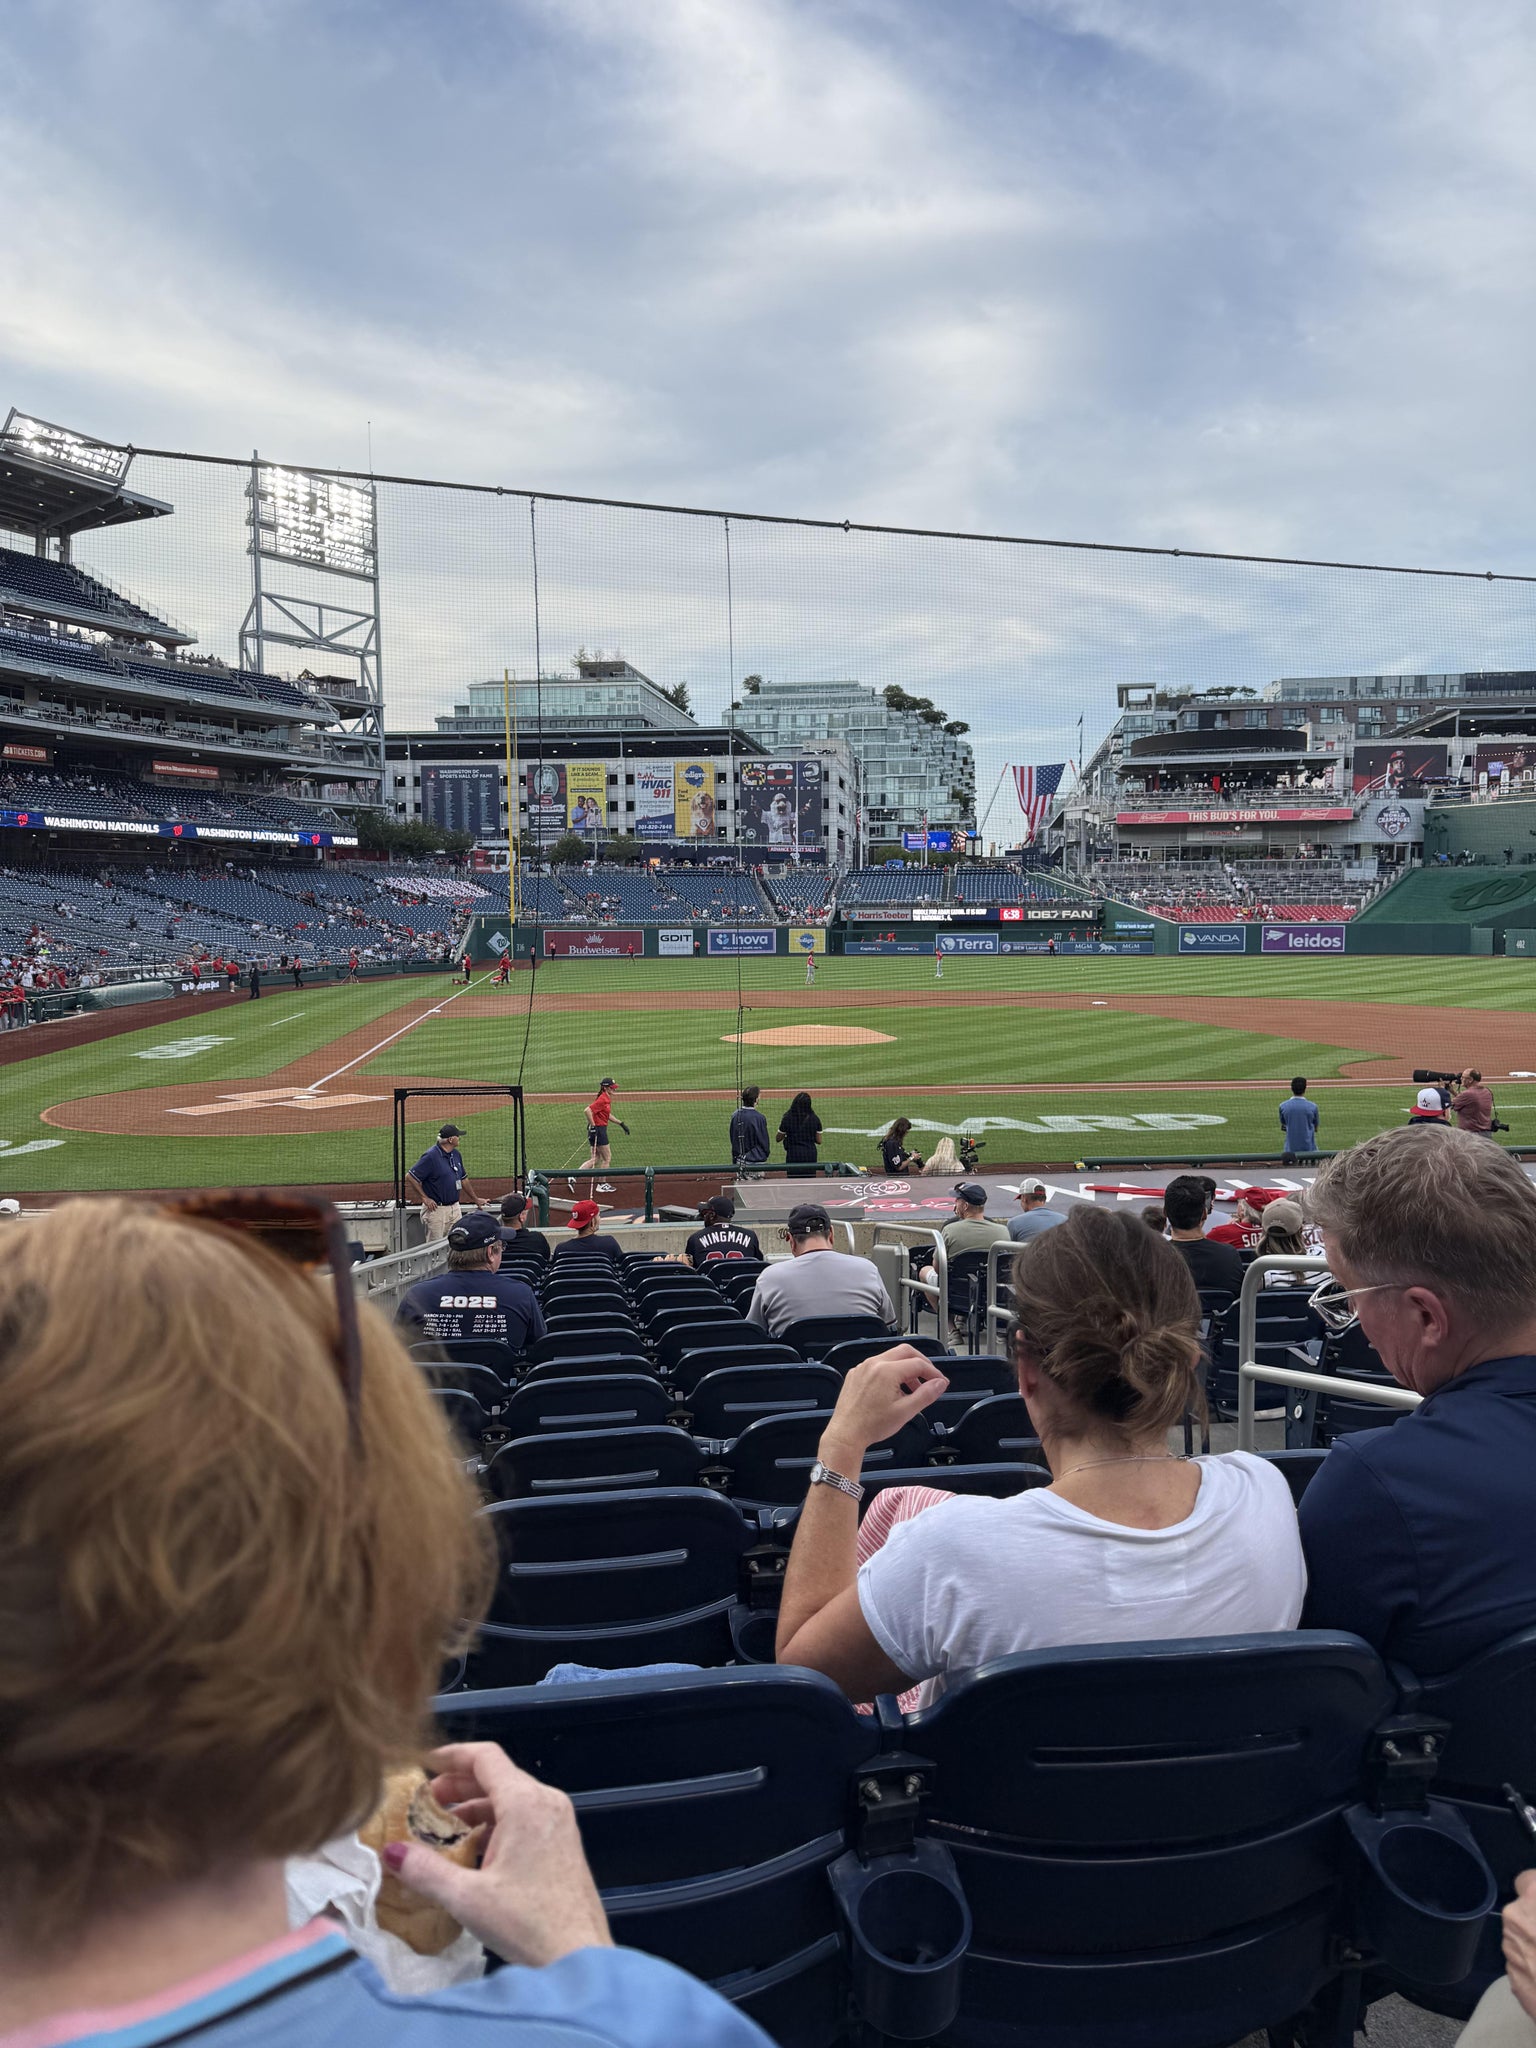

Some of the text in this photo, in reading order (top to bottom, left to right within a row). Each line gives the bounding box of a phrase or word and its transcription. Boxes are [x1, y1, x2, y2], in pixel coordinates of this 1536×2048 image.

[641, 780, 672, 789] HVAC
[653, 789, 671, 798] 911
[1188, 810, 1280, 821] THIS BUD'S FOR YOU.
[44, 816, 160, 834] WASHINGTON NATIONALS
[196, 827, 299, 842] WASHINGTON NATIONALS
[858, 911, 882, 919] Harris
[883, 911, 909, 919] Teeter
[1003, 910, 1020, 919] 6:38
[1062, 910, 1092, 919] FAN
[660, 934, 692, 942] GDIT
[732, 933, 768, 945] Inova
[1196, 934, 1240, 942] VANDA
[1288, 933, 1342, 948] leidos
[568, 945, 620, 954] Budweiser
[956, 938, 993, 950] Terra
[866, 1113, 1229, 1136] AARP
[699, 1230, 752, 1248] WINGMAN
[439, 1295, 497, 1309] 2025
